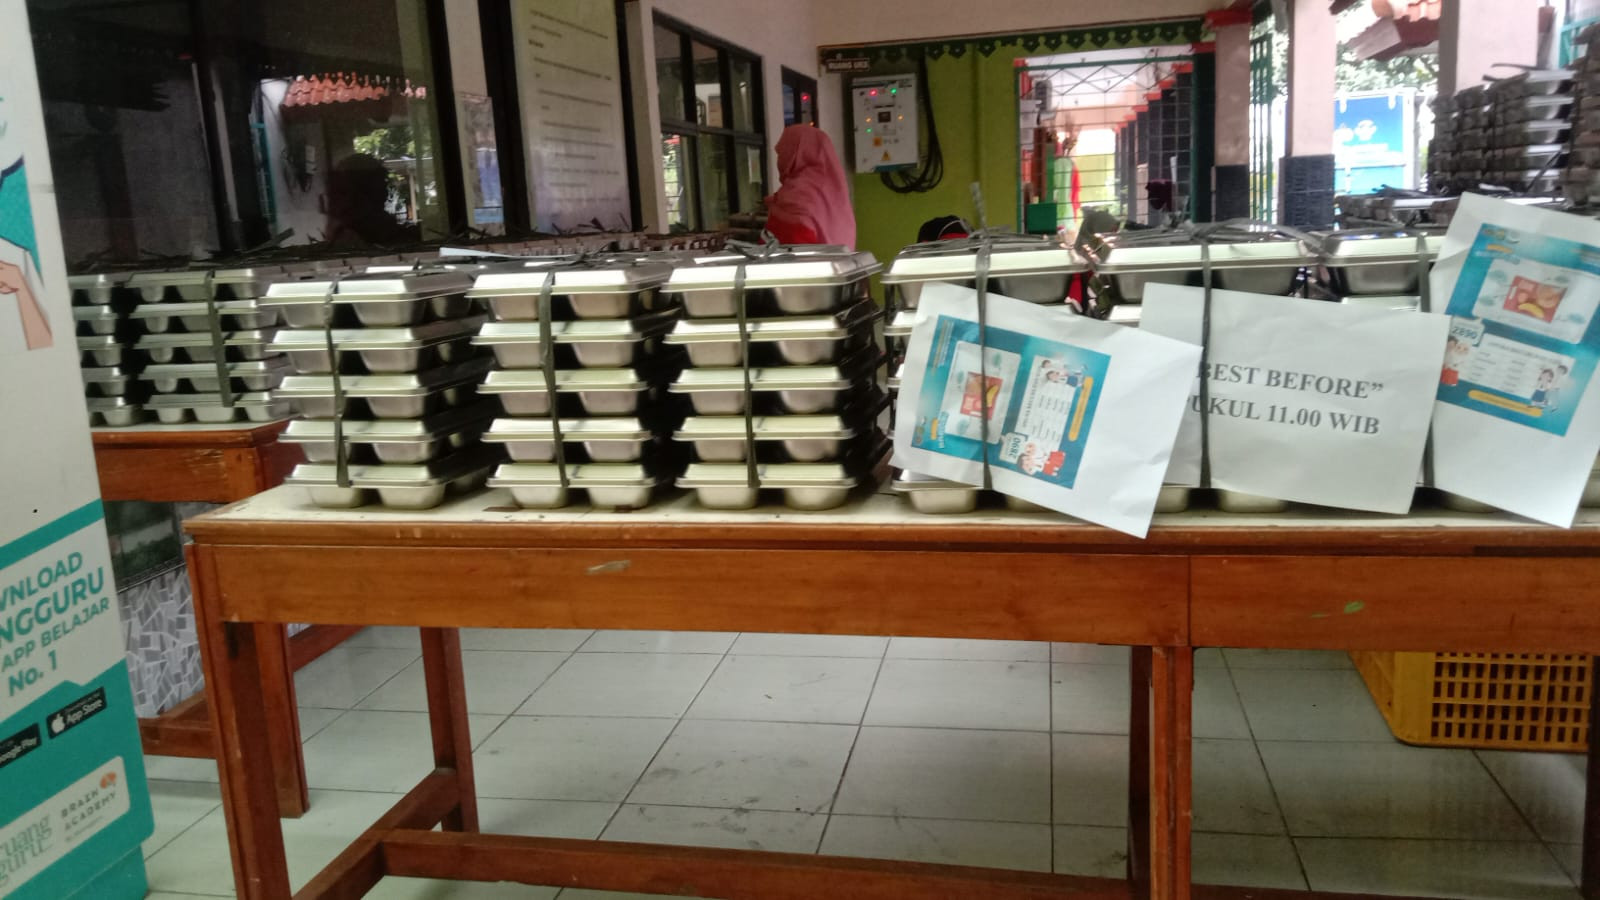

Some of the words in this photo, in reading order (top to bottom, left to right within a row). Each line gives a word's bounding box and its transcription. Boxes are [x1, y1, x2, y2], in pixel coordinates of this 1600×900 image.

[1267, 404, 1321, 427] 11.00
[1329, 411, 1380, 435] WIB
[2, 640, 36, 673] APP
[41, 597, 110, 648] BELAJAR
[48, 650, 57, 671] 1
[60, 788, 99, 818] BRAIN
[65, 792, 117, 831] ACADEMY
